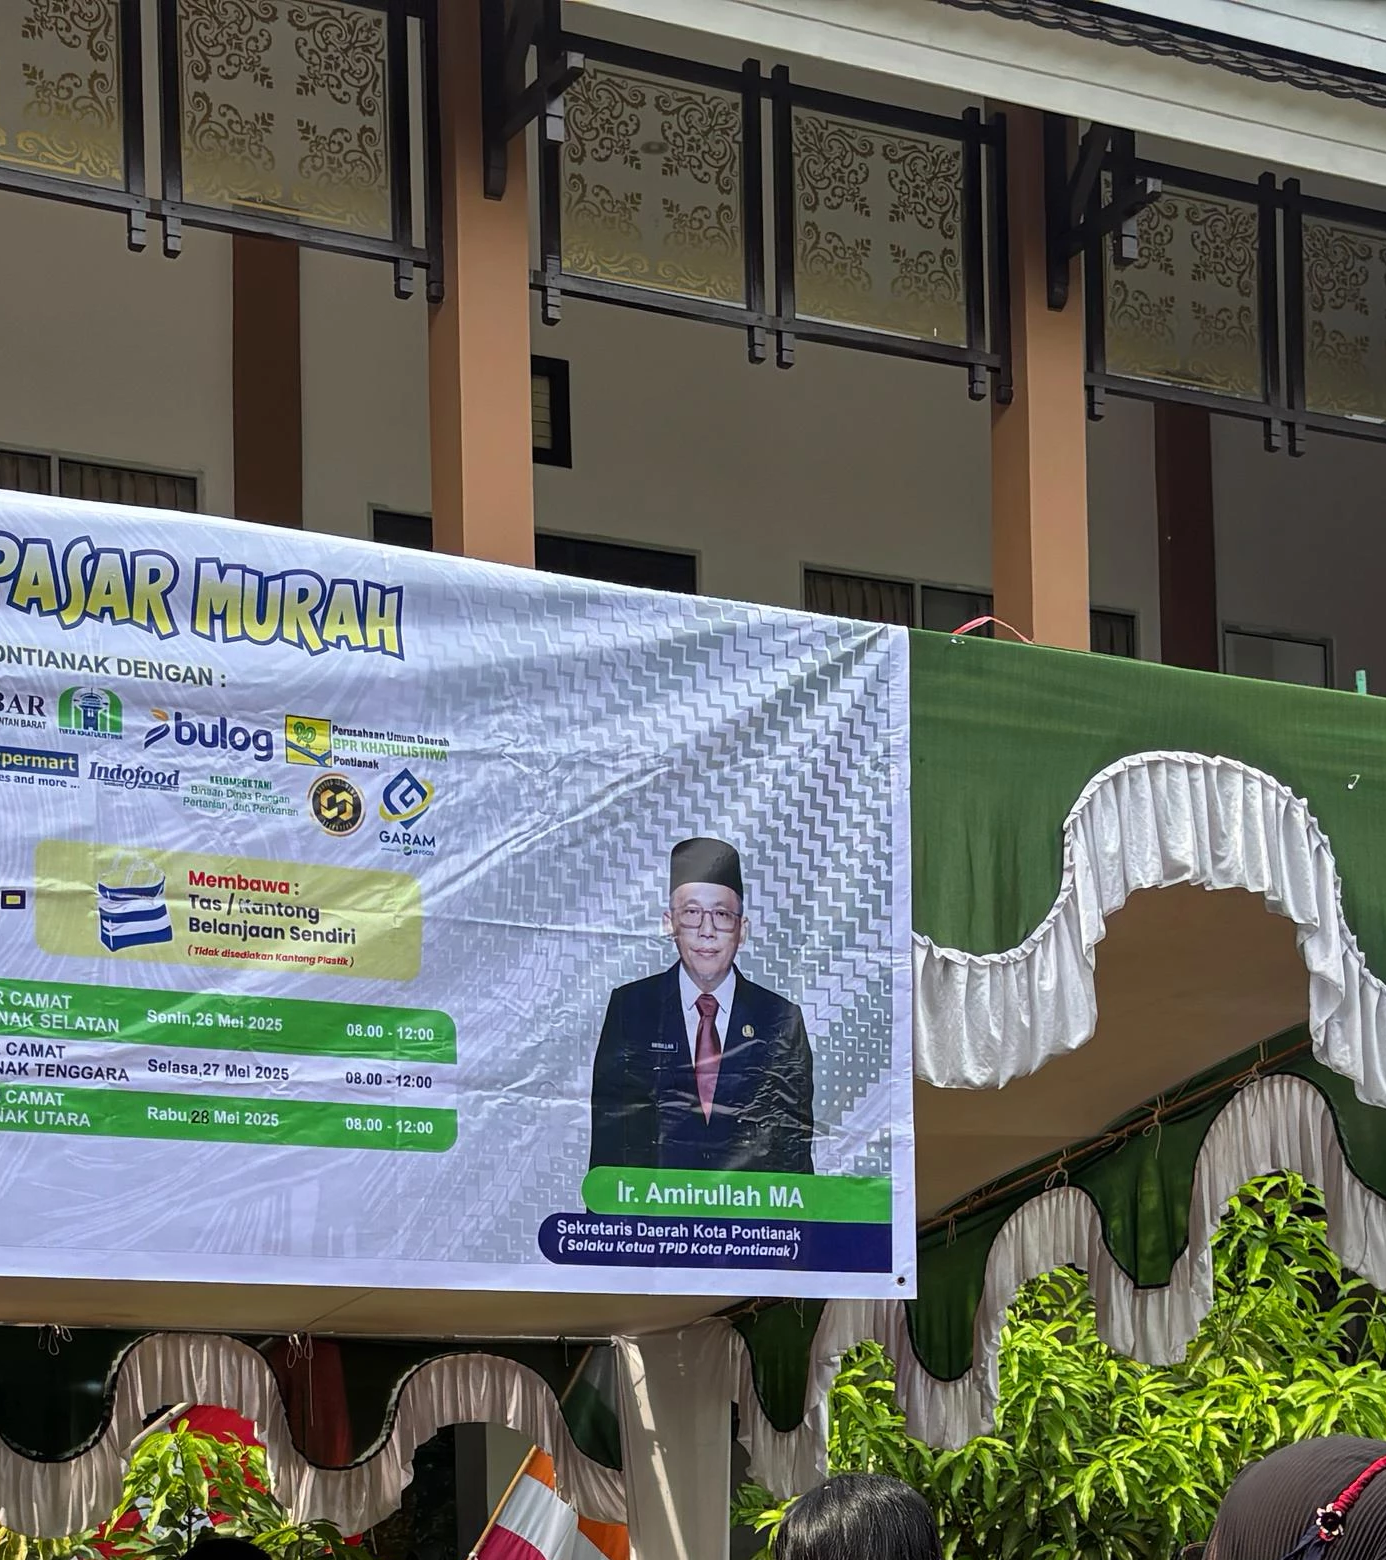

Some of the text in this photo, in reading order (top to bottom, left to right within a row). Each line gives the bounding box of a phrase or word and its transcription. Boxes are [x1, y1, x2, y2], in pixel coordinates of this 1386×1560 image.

[192, 557, 405, 661] MURAH
[117, 660, 212, 686] DENGAN
[20, 718, 47, 730] BARAT
[174, 711, 273, 762] bulog
[332, 724, 450, 748] Perusahaan Umum Daerah
[333, 738, 448, 762] BPR KHATULISTIWA
[333, 757, 379, 770] Pontianak
[13, 773, 34, 785] and
[38, 777, 67, 788] more
[88, 762, 180, 789] Indofood
[379, 830, 436, 848] GARAM
[188, 894, 320, 924] Tas Kantong
[188, 917, 356, 945] Belanjaan Sendiri
[194, 945, 348, 967] Tidak disediakan Kantong Plastik
[10, 991, 72, 1010] CAMAT
[40, 1015, 119, 1033] SELATAN
[147, 1009, 435, 1041] Senin,26 Mei 2025 08.00 12:00
[6, 1041, 66, 1060] CAMAT
[35, 1063, 130, 1082] TENGGARA
[147, 1059, 432, 1089] Selasa,27 Mei 2025 08.00 12:00
[5, 1089, 65, 1107] CAMAT
[35, 1111, 91, 1128] UTARA
[214, 1111, 240, 1125] Mei
[244, 1112, 279, 1127] 2025
[345, 1117, 383, 1132] 08.00
[396, 1120, 433, 1134] 12:00
[617, 1180, 804, 1209] Ir. Amirullah MA
[557, 1219, 801, 1242] Sekretaris Daerah Kota Pontianak
[567, 1238, 791, 1257] Selaku Ketua TPID Kota Pontianak
